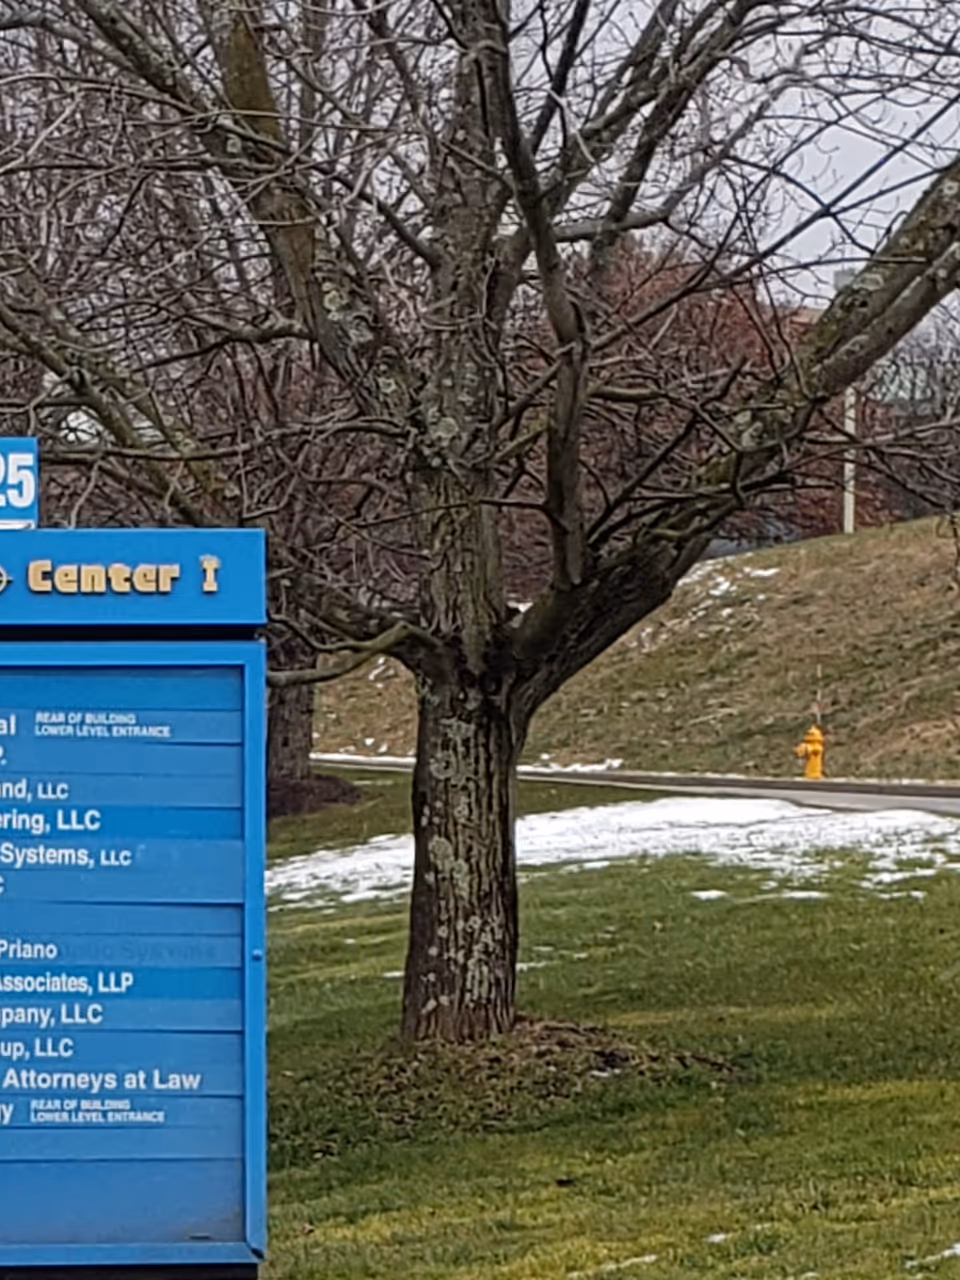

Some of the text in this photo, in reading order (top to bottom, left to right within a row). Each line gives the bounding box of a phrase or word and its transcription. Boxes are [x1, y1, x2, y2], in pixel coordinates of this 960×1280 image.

[27, 560, 180, 593] Center
[35, 711, 137, 725] REAR OF BUILDING
[34, 724, 171, 738] LOWER LEVEL ENTRANCE
[37, 782, 69, 800] LLC
[56, 809, 101, 831] LLC
[0, 841, 95, 869] Systems,
[100, 849, 132, 867] LLC
[98, 972, 135, 994] LLP
[60, 1003, 104, 1025] LLC
[34, 1037, 74, 1058] LLC
[2, 1068, 117, 1095] Attorneys
[123, 1070, 146, 1091] at
[152, 1069, 202, 1091] Law
[29, 1099, 132, 1112] REAR OF BUILDING
[29, 1110, 166, 1123] LOWER LEVEL ENTRANCE
